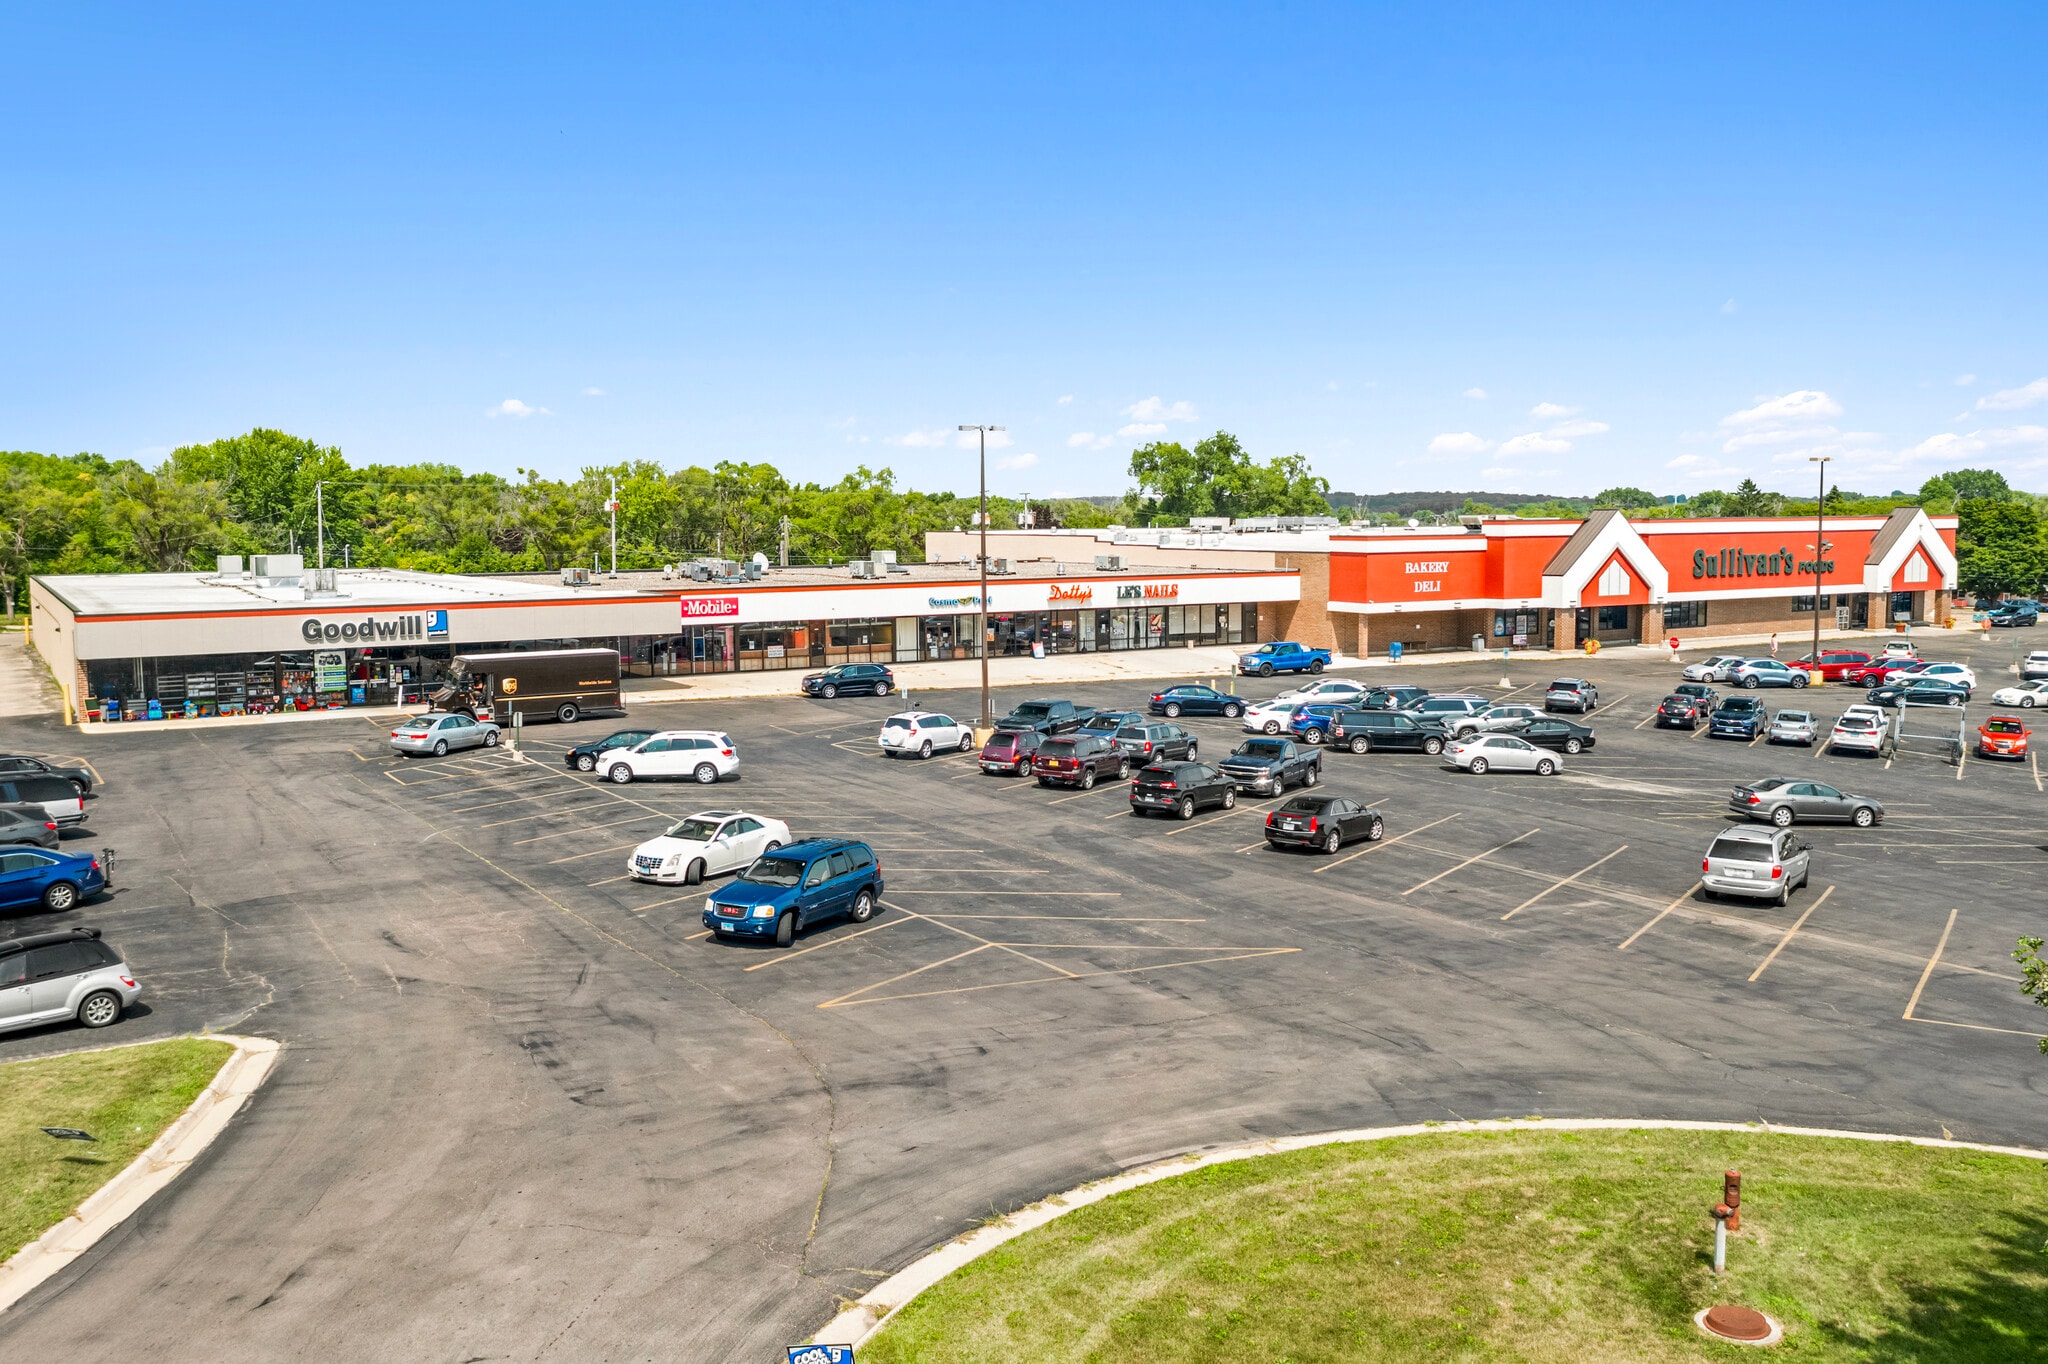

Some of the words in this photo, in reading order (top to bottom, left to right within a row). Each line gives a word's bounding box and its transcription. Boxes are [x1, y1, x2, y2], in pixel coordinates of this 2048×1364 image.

[1405, 561, 1449, 574] BAKERY
[1693, 547, 1794, 578] Sullivan's
[1143, 584, 1178, 598] NAILS
[1414, 580, 1441, 593] DELI
[1048, 584, 1093, 604] Dotty's
[929, 597, 959, 606] Cosmo
[302, 615, 421, 640] Goodwill
